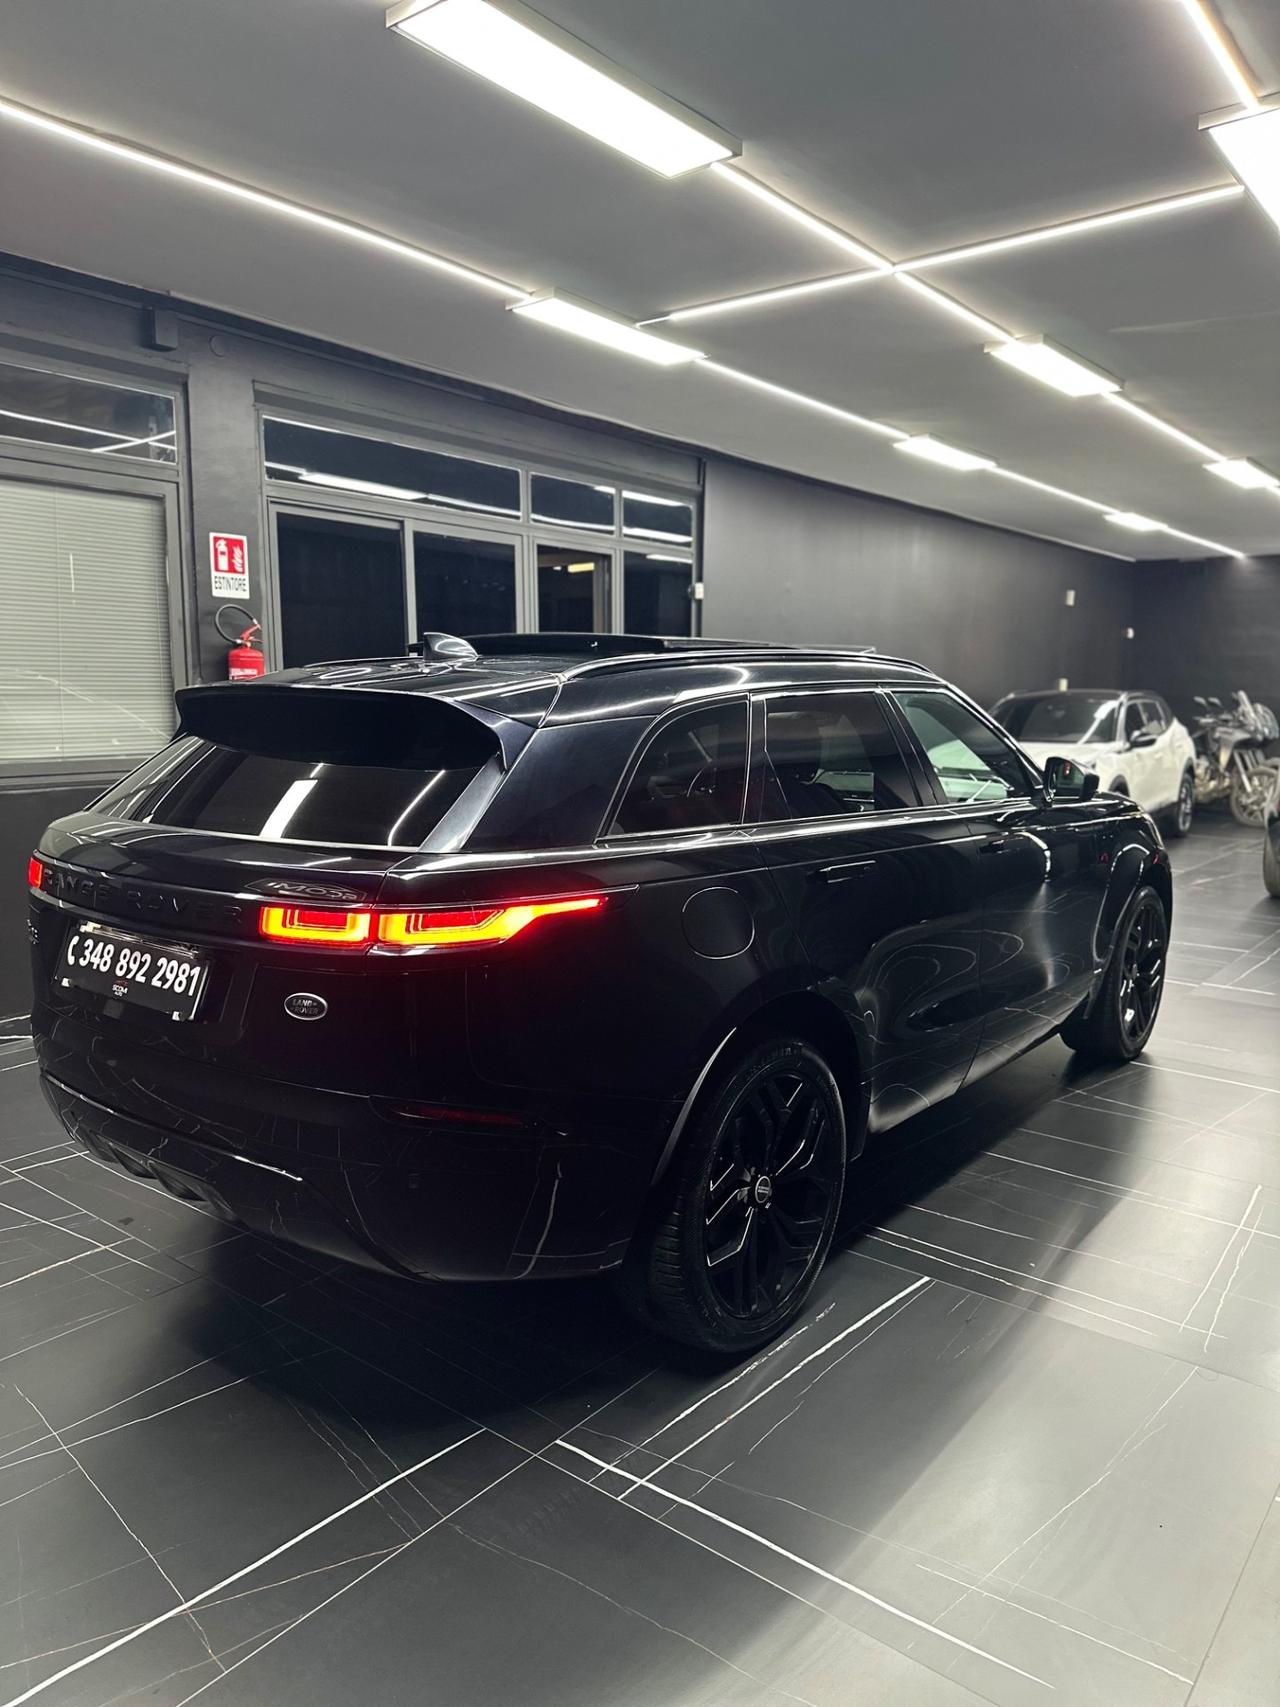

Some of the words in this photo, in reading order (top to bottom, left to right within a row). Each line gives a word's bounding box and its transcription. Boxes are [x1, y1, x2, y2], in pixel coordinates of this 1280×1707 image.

[214, 575, 247, 592] ESTINTORE
[79, 939, 115, 972] 348
[115, 948, 151, 983] 892
[151, 957, 201, 997] 2981
